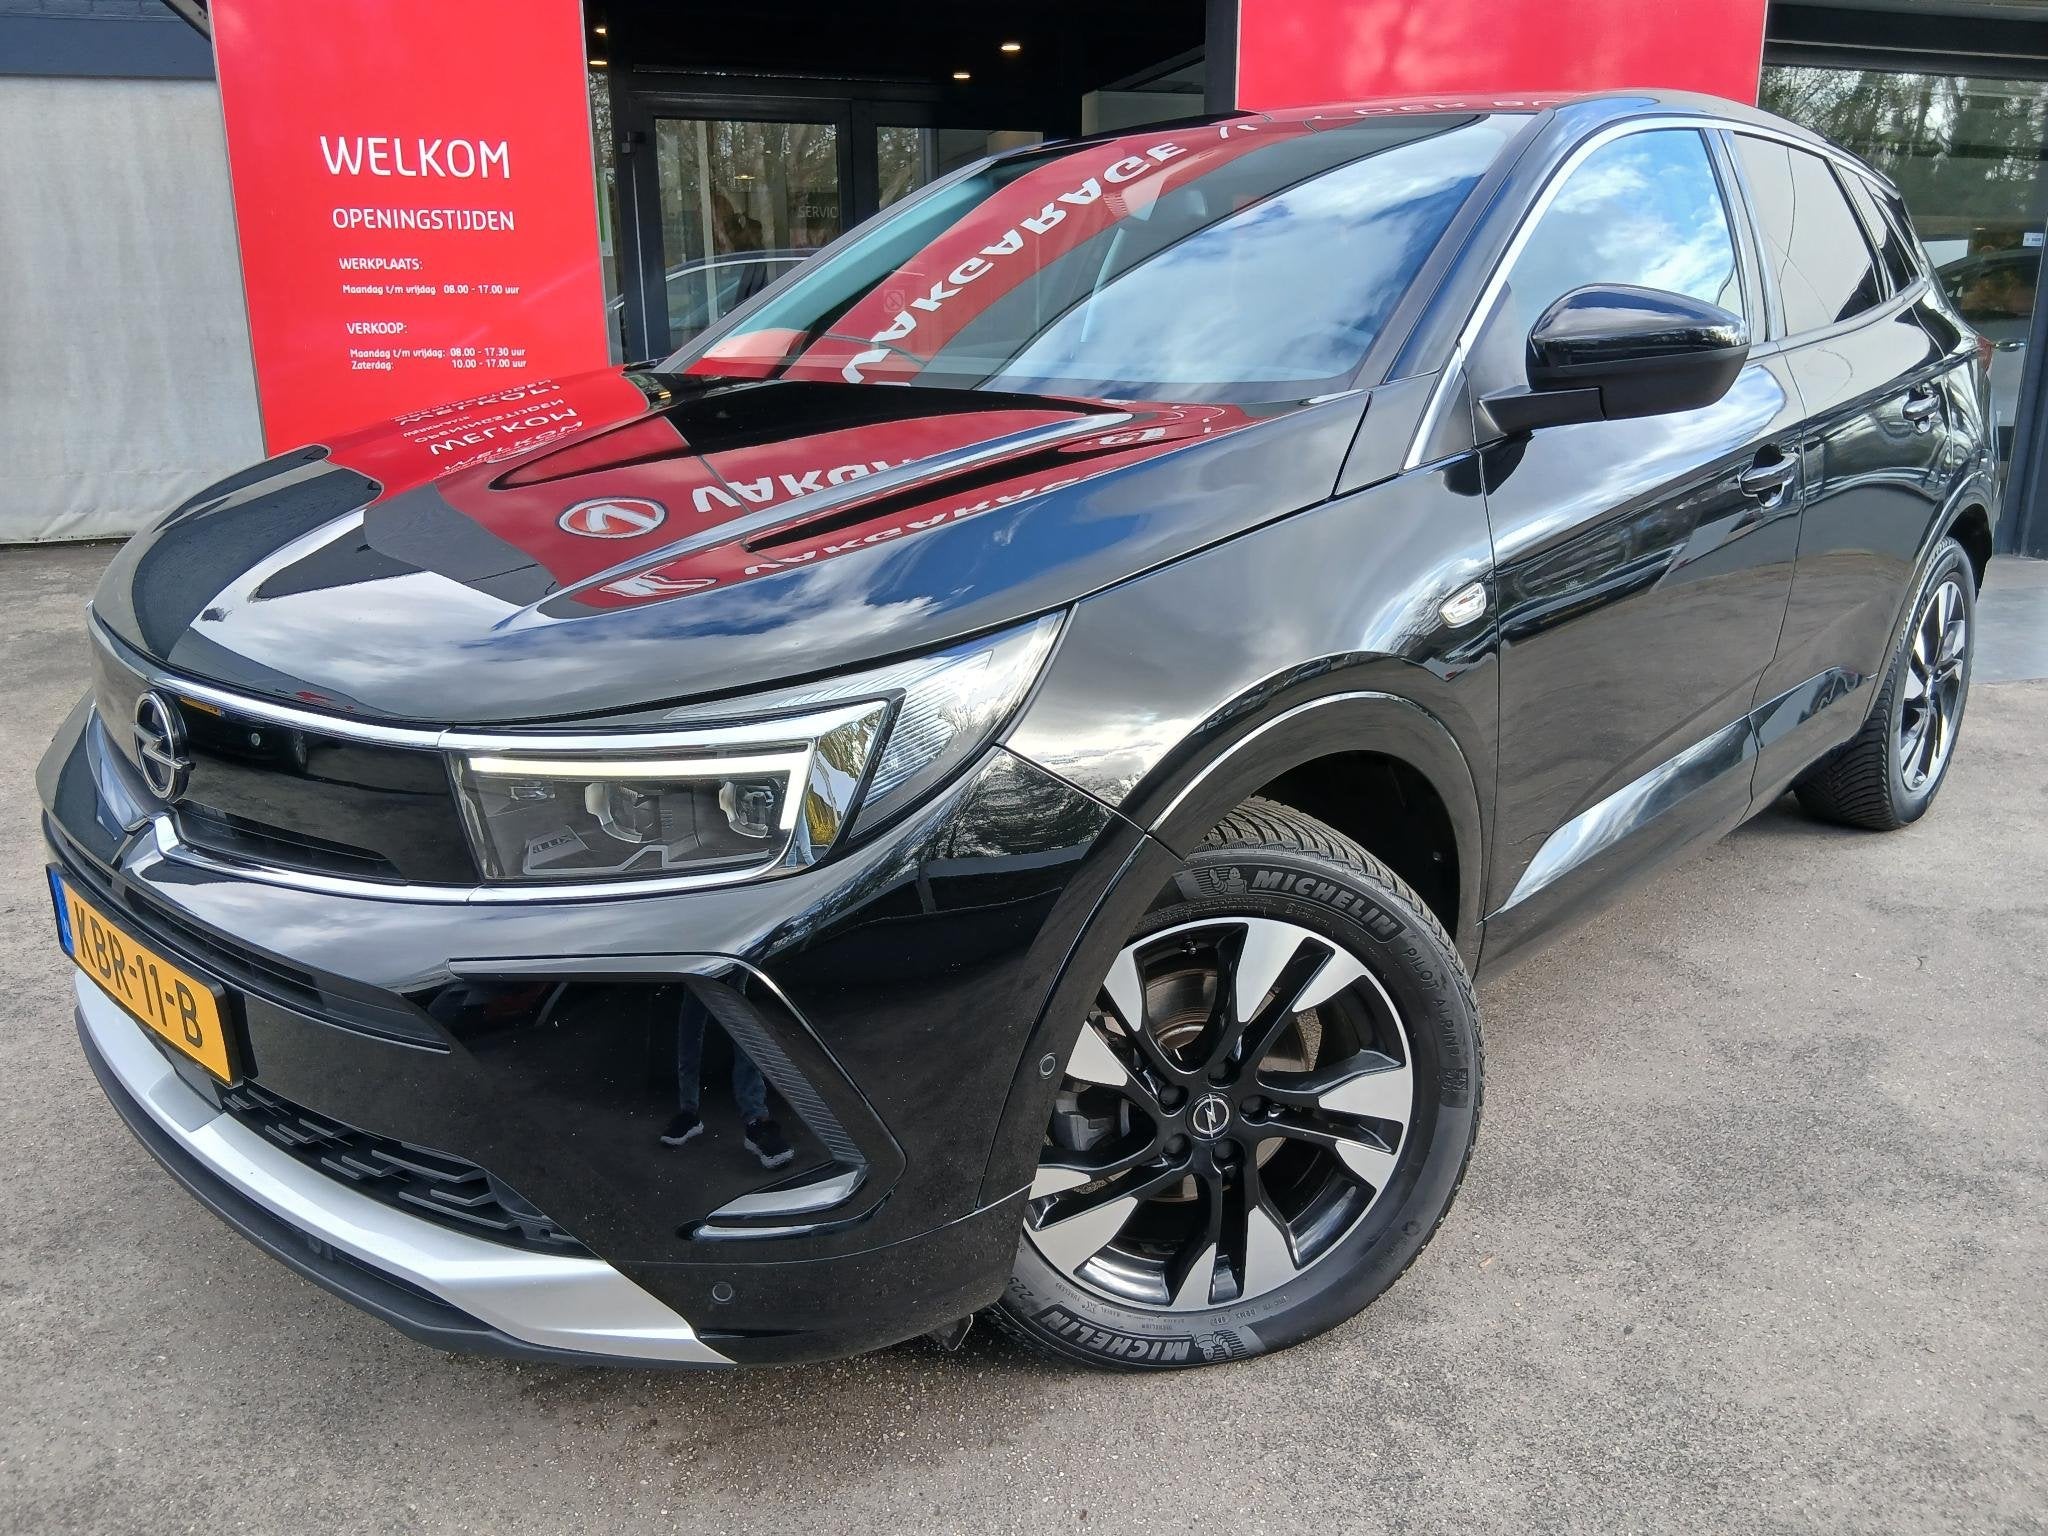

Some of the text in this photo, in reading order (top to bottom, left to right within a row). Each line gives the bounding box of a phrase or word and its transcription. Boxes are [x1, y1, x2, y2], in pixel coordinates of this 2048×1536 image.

[319, 135, 510, 179] WELKOM
[332, 208, 515, 231] OPENINGSTIJDEN
[338, 257, 423, 270] WERKPLAATS:
[342, 284, 384, 295] Maandag
[385, 285, 404, 294] t/m
[405, 285, 437, 296] vrijdag
[443, 284, 469, 294] 08.00
[477, 284, 503, 294] 17.00
[504, 286, 520, 294] uur
[346, 321, 408, 335] VERKOOP:
[349, 348, 391, 359] Maandag
[392, 349, 411, 358] t/m
[412, 348, 446, 359] vrijdag:
[449, 347, 476, 357] 08.00
[484, 347, 510, 356] 17.30
[510, 348, 526, 356] uur
[351, 360, 394, 372] Zaterdag:
[451, 359, 477, 369] 10.00
[485, 358, 511, 368] 17.00
[511, 360, 527, 368] uur
[1251, 869, 1398, 936] MICHELIN
[73, 900, 203, 1049] KBR-11-B
[1402, 946, 1440, 992] PILOT
[1040, 1310, 1191, 1361] MICHELIN
